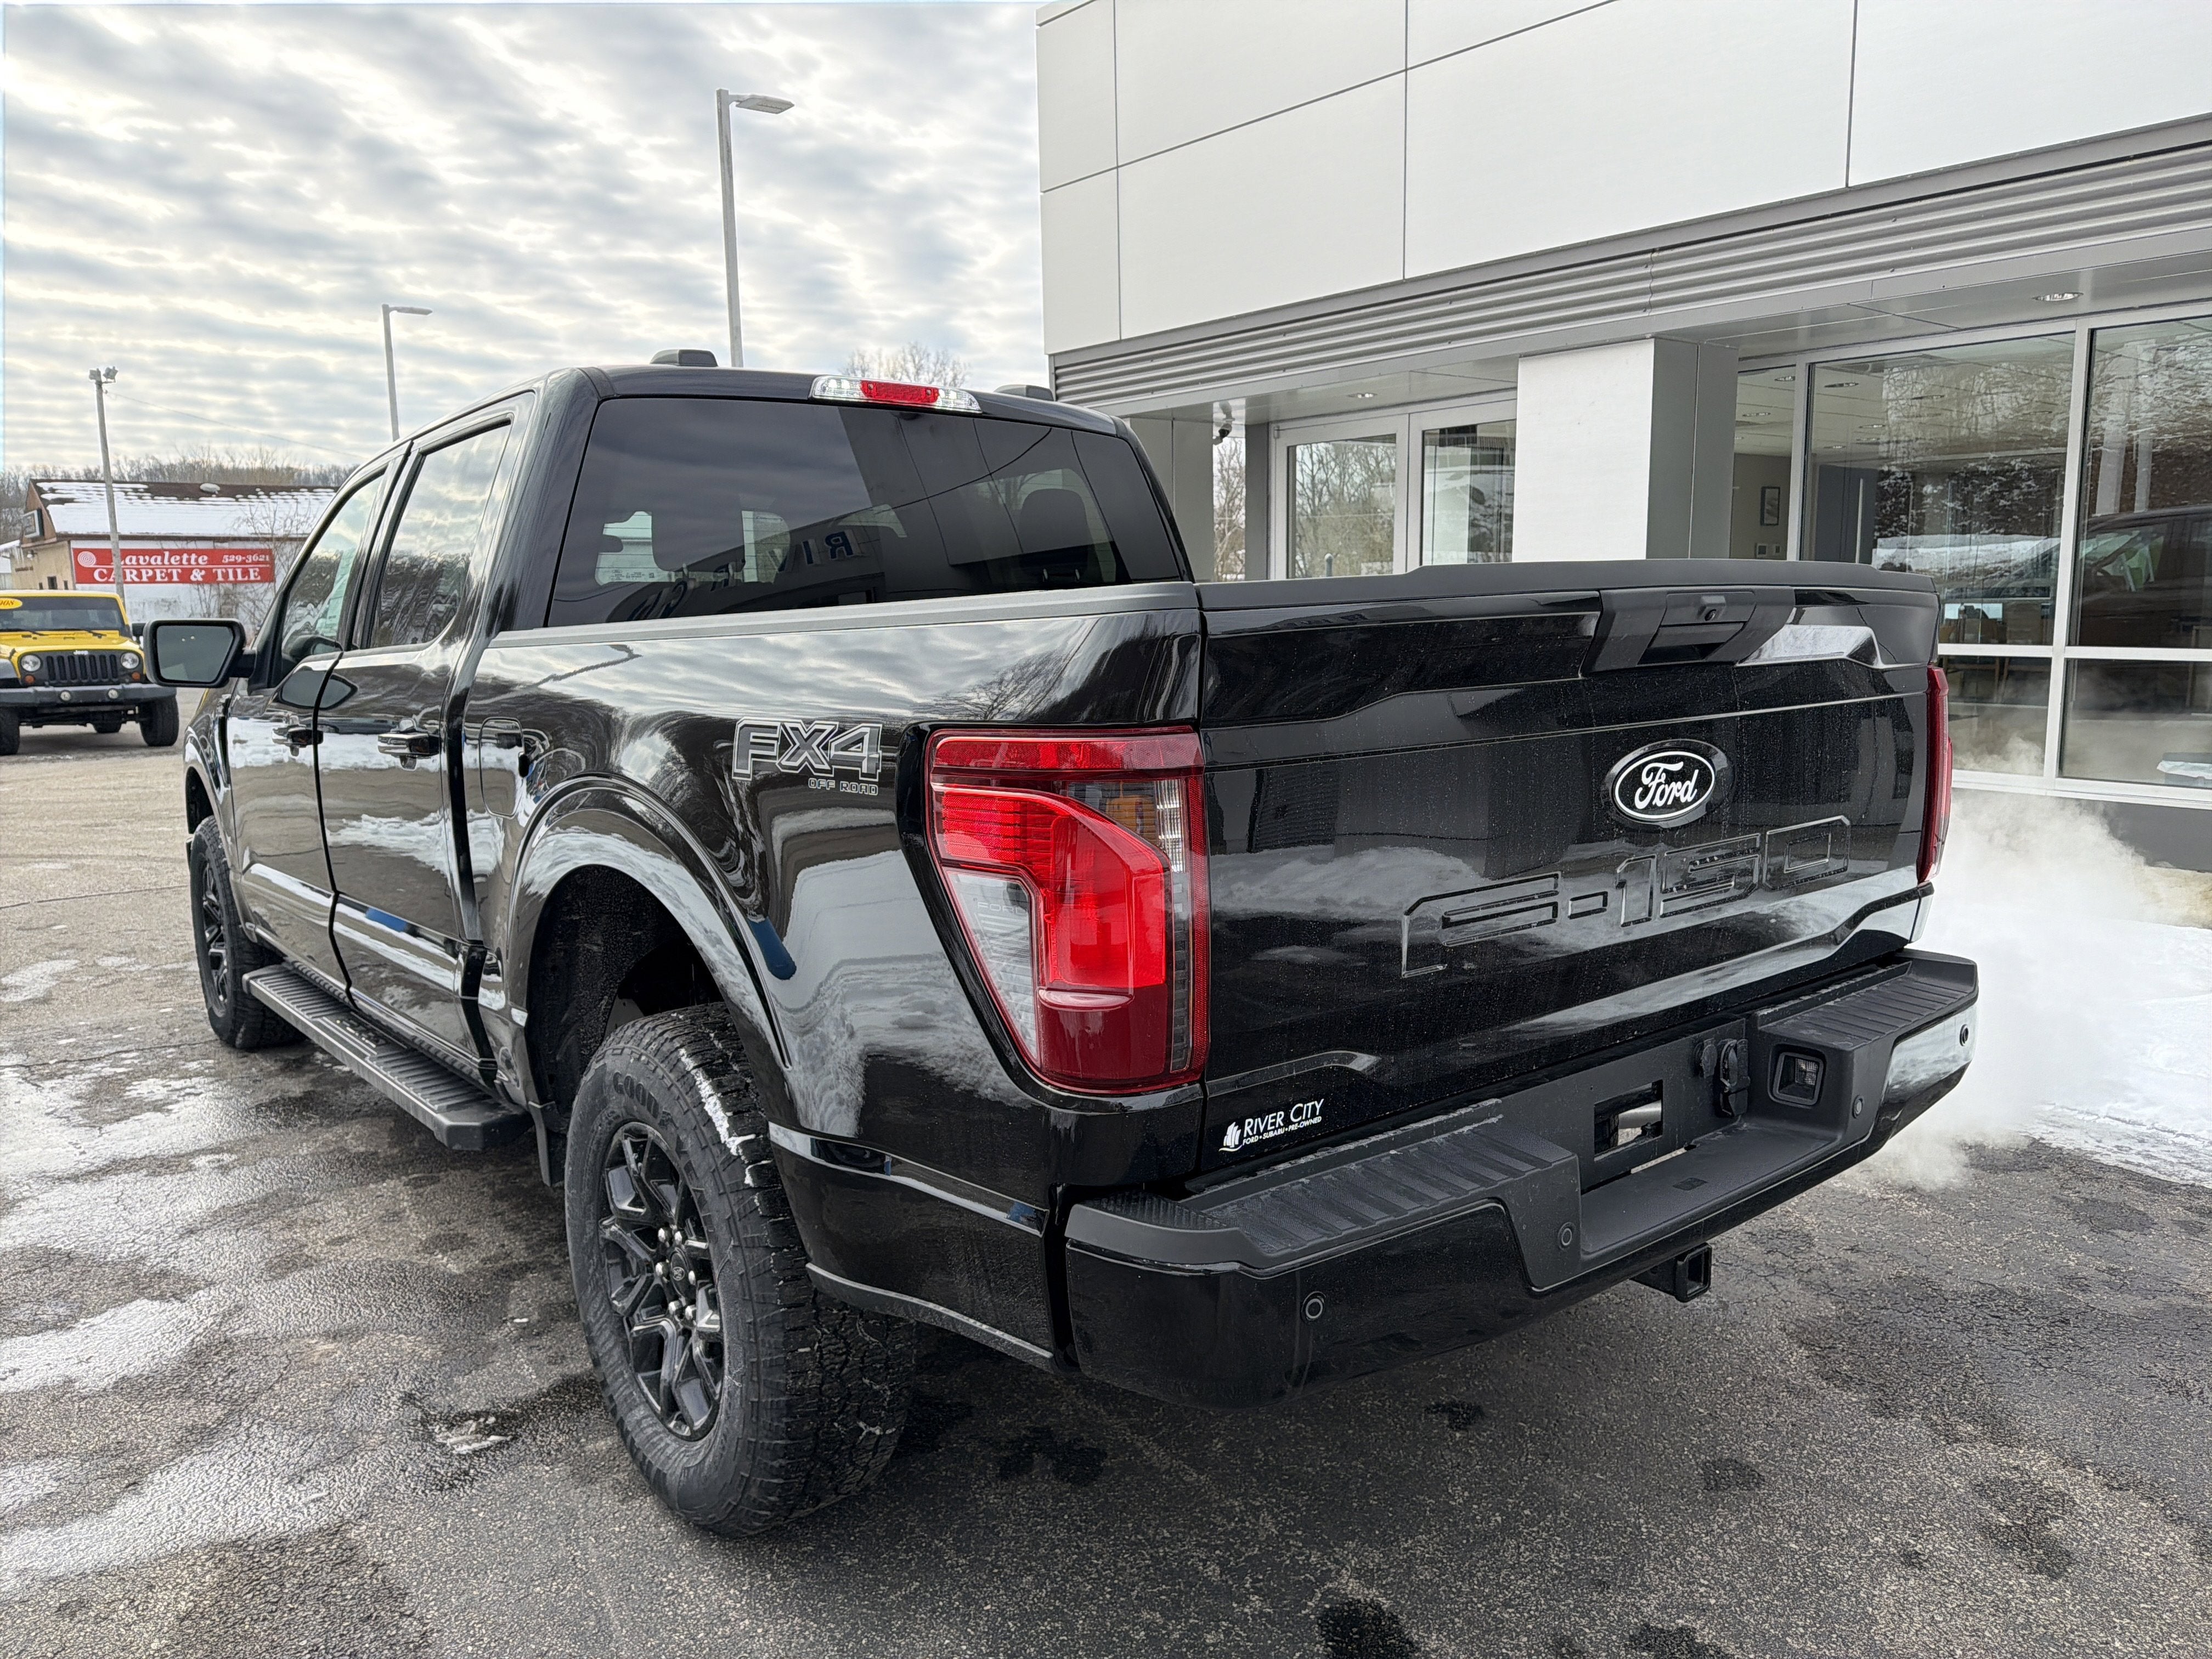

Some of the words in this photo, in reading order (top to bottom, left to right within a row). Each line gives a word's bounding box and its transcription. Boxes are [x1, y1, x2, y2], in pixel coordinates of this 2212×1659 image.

[111, 551, 208, 566] avalette
[222, 554, 269, 563] 529-3621
[190, 568, 206, 582] &
[212, 567, 261, 582] TILE
[732, 716, 882, 781] FX4
[808, 777, 836, 790] OFF
[839, 780, 878, 795] ROAD
[1634, 761, 1700, 810] Ford
[1402, 815, 1850, 978] F-150
[1243, 1111, 1284, 1137] RIVER
[1290, 1098, 1324, 1122] CITY
[1243, 1136, 1259, 1146] FORD
[1262, 1127, 1285, 1139] SUBARU
[1288, 1116, 1322, 1132] PRE-OWNED
